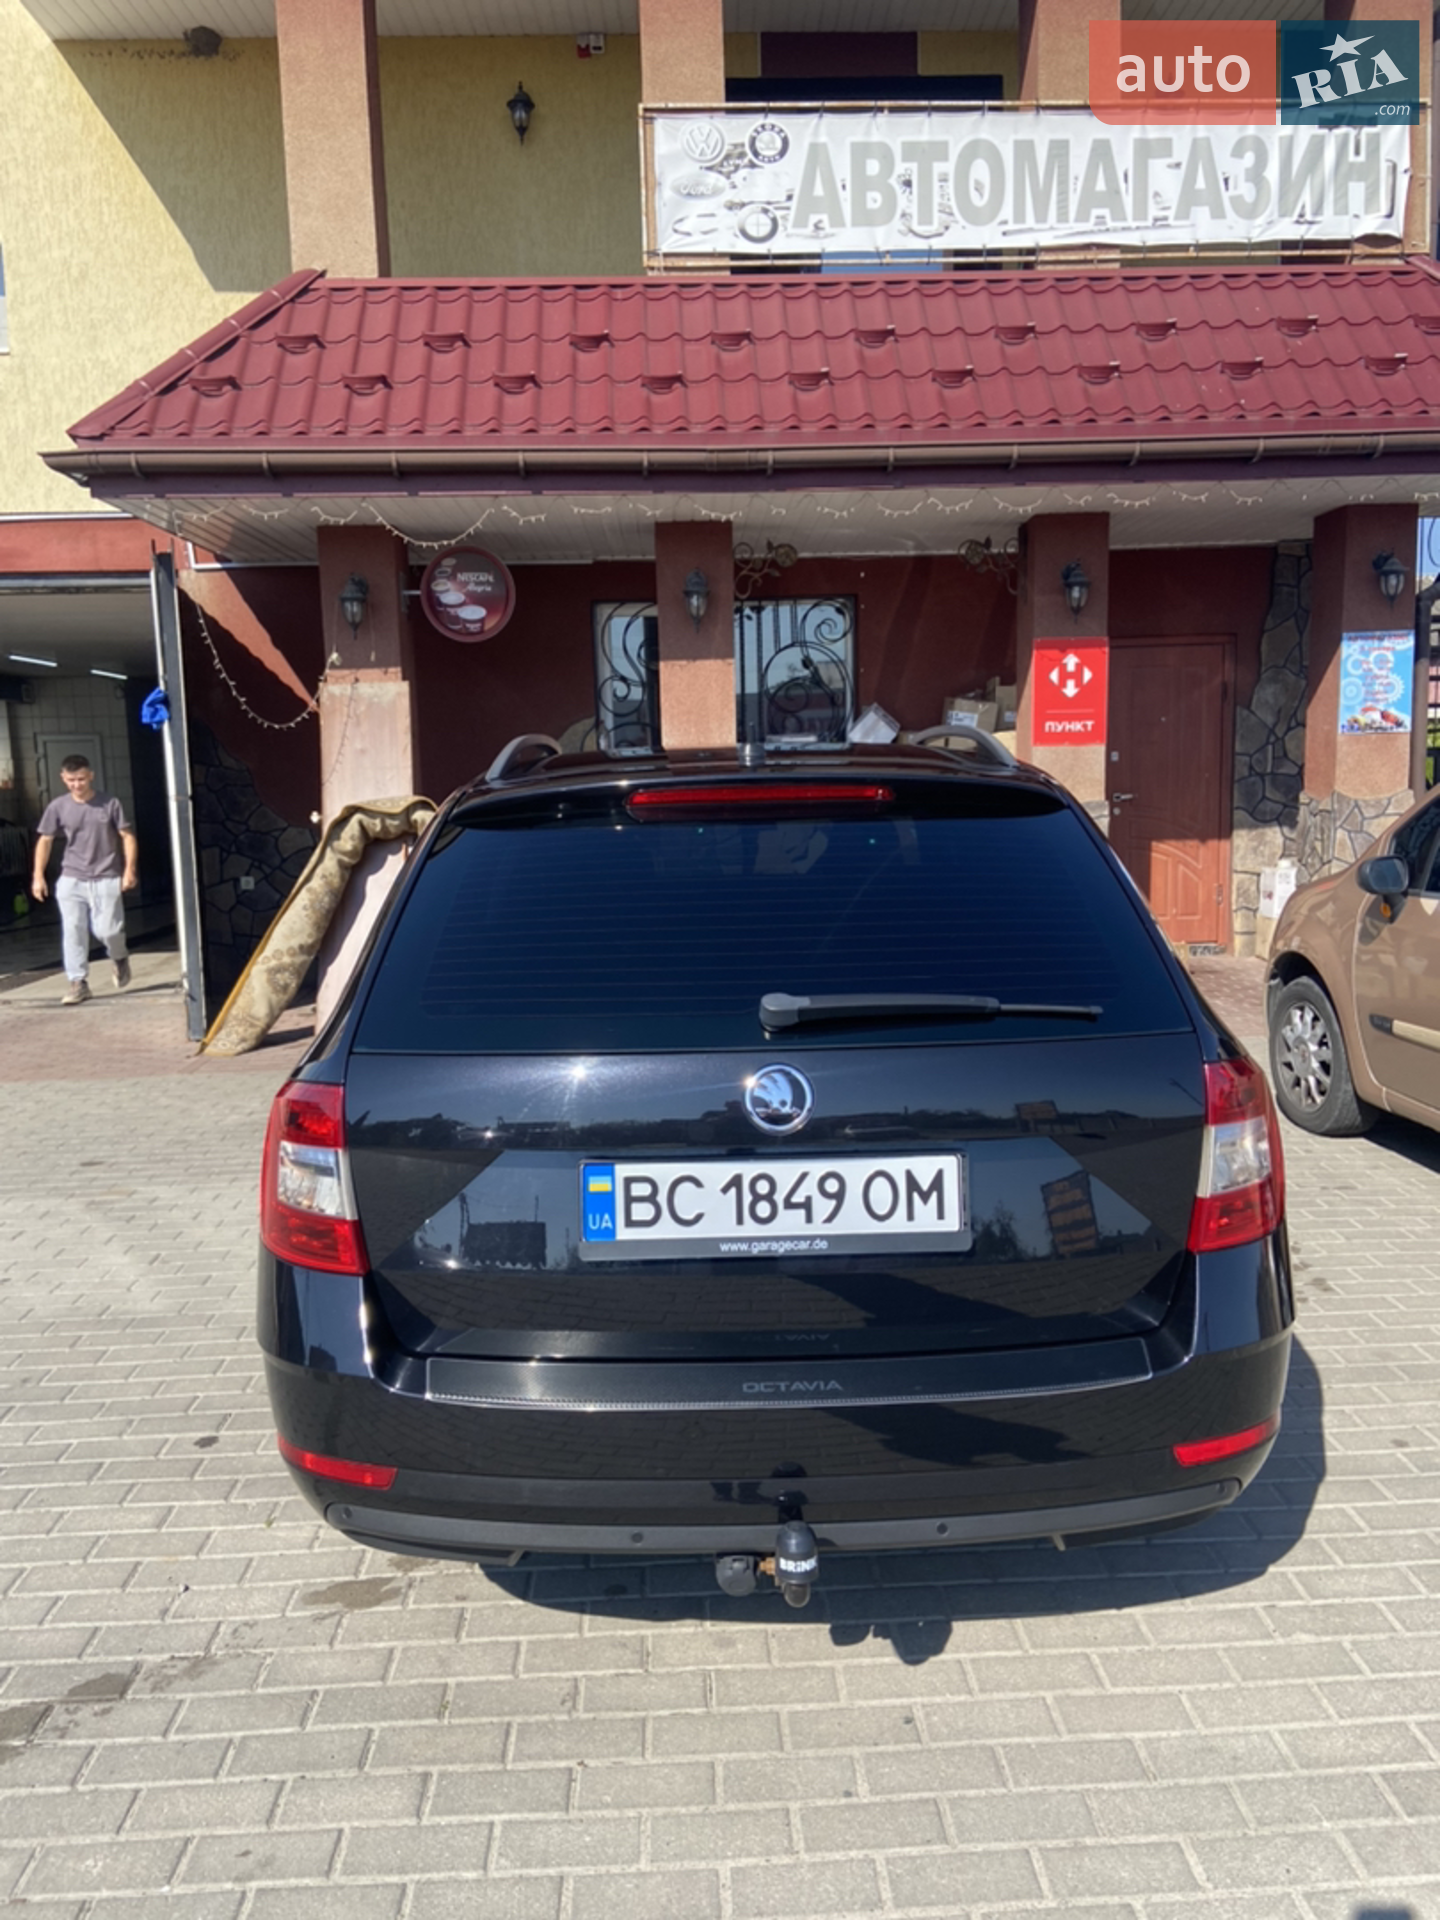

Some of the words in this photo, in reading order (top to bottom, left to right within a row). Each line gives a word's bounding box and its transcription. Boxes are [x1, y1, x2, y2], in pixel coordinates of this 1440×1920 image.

[791, 132, 1384, 229] АВТОМАГАЗИН
[1044, 720, 1095, 733] ПУНКТ
[623, 1174, 705, 1229] BC
[719, 1170, 846, 1226] 1849
[862, 1168, 945, 1222] OM
[588, 1213, 613, 1230] UA
[719, 1238, 829, 1254] www.garagecar.de
[742, 1380, 843, 1393] OCTAVIA
